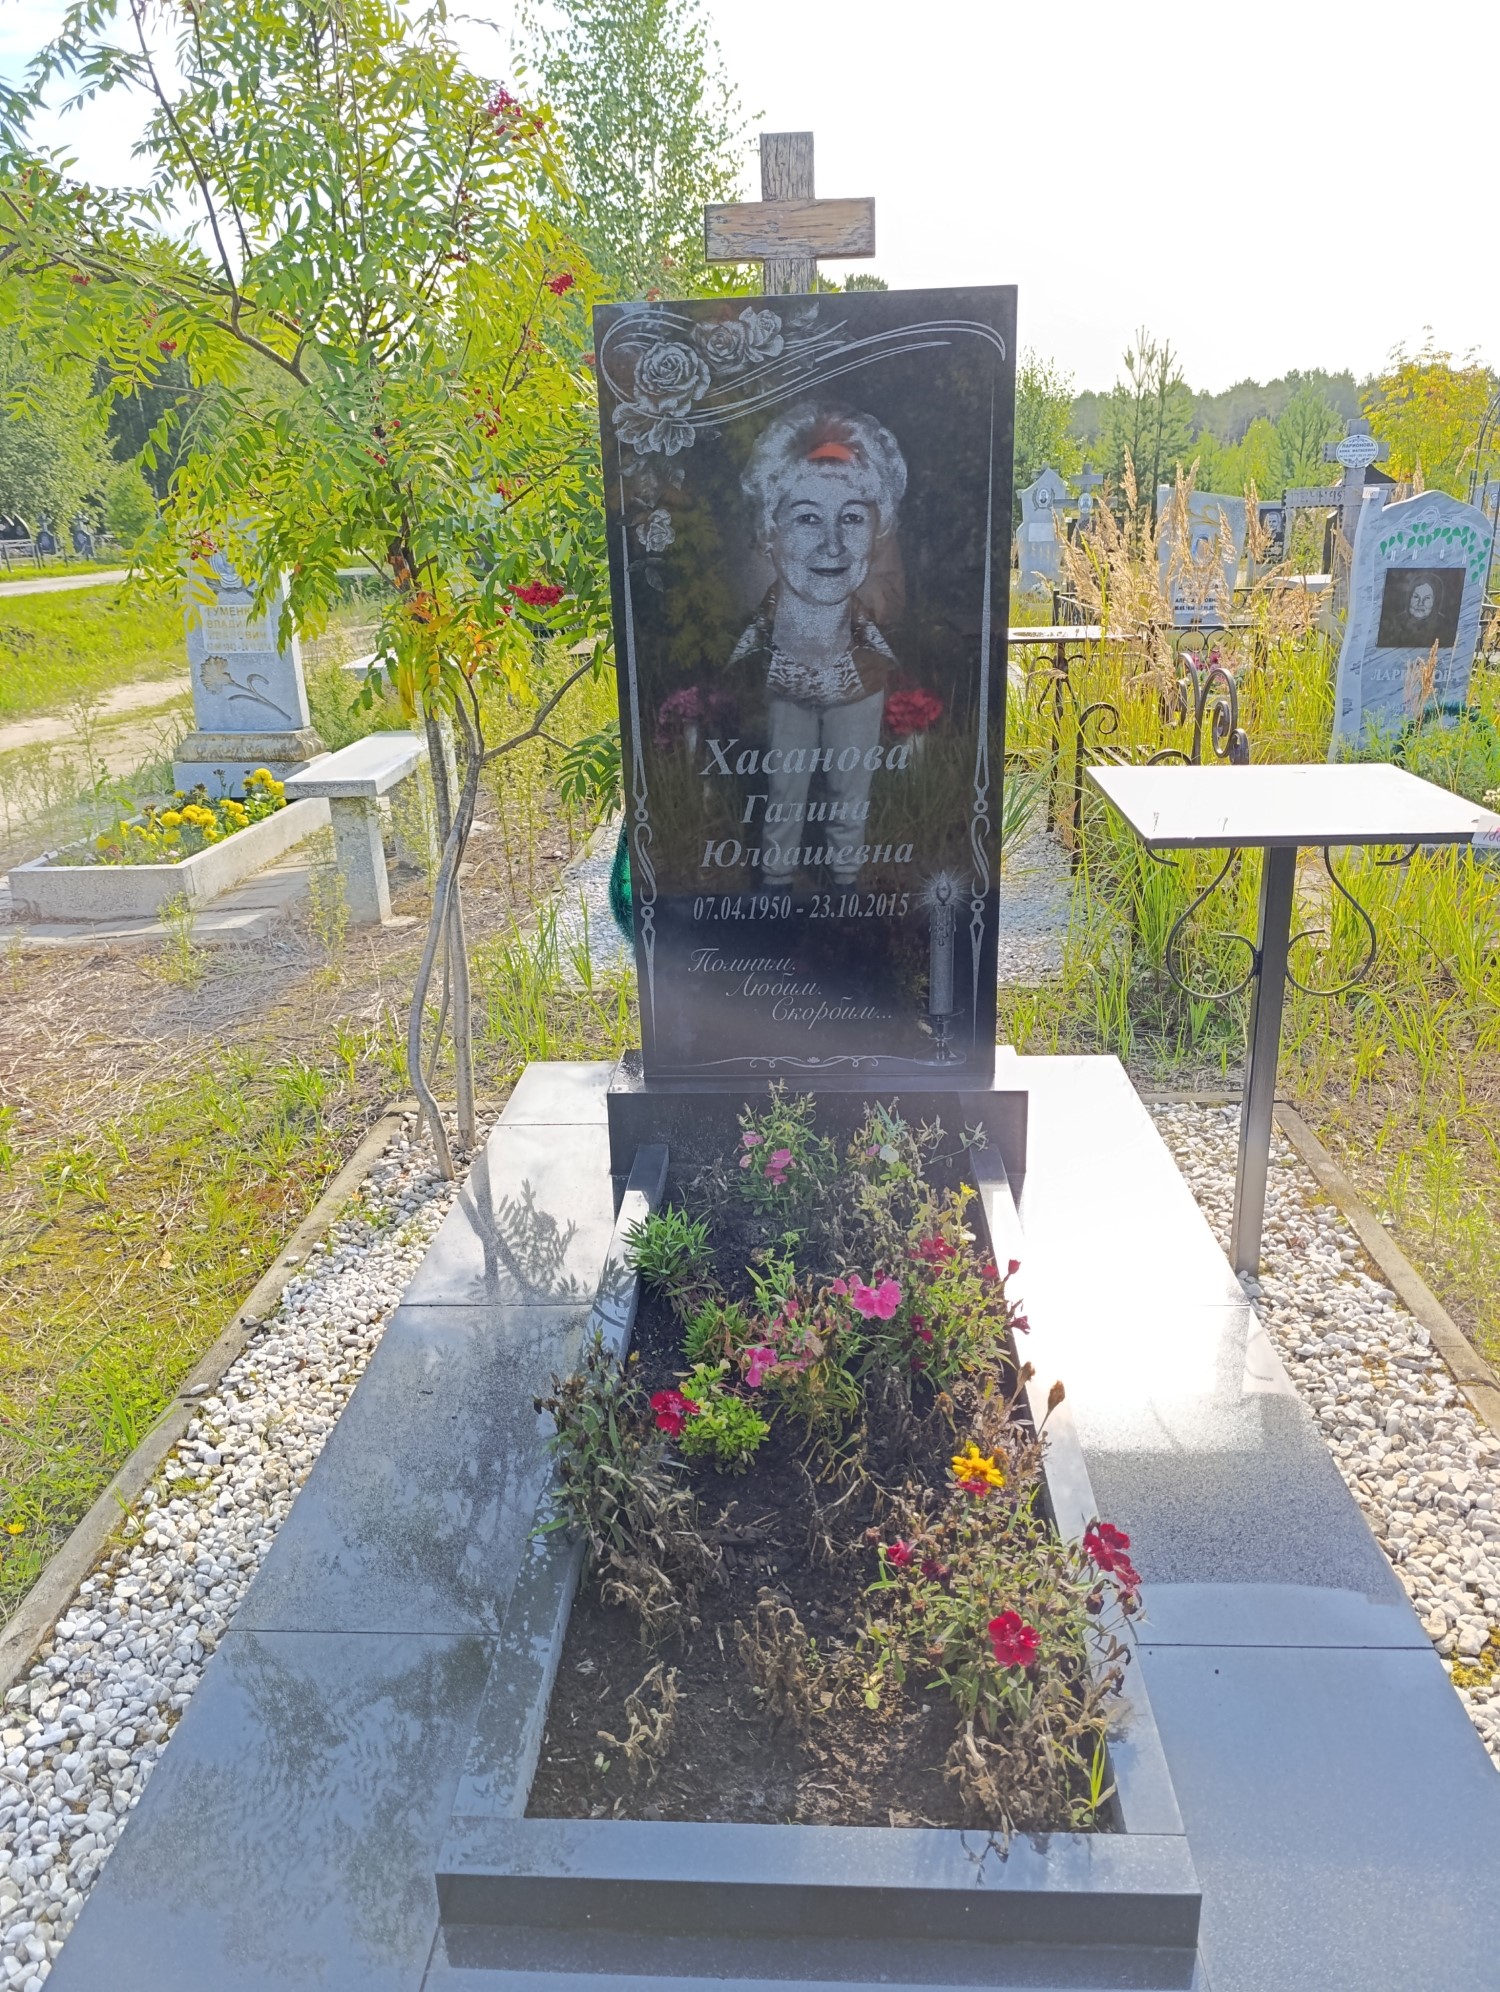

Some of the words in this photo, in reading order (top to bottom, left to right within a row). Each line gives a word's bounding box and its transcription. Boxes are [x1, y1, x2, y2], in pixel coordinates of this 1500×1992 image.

[207, 606, 256, 617] ГУМЕНК
[1371, 667, 1460, 682] ЛАРОВА
[698, 738, 911, 775] Хасанова
[740, 794, 871, 824] Галина
[699, 839, 914, 868] Юлдашевна
[693, 896, 791, 920] 07.04.1950
[809, 893, 910, 918] 23.10.2015
[688, 948, 797, 972] Помним.
[725, 973, 822, 997] Любим.
[772, 996, 892, 1030] Скорбим...
